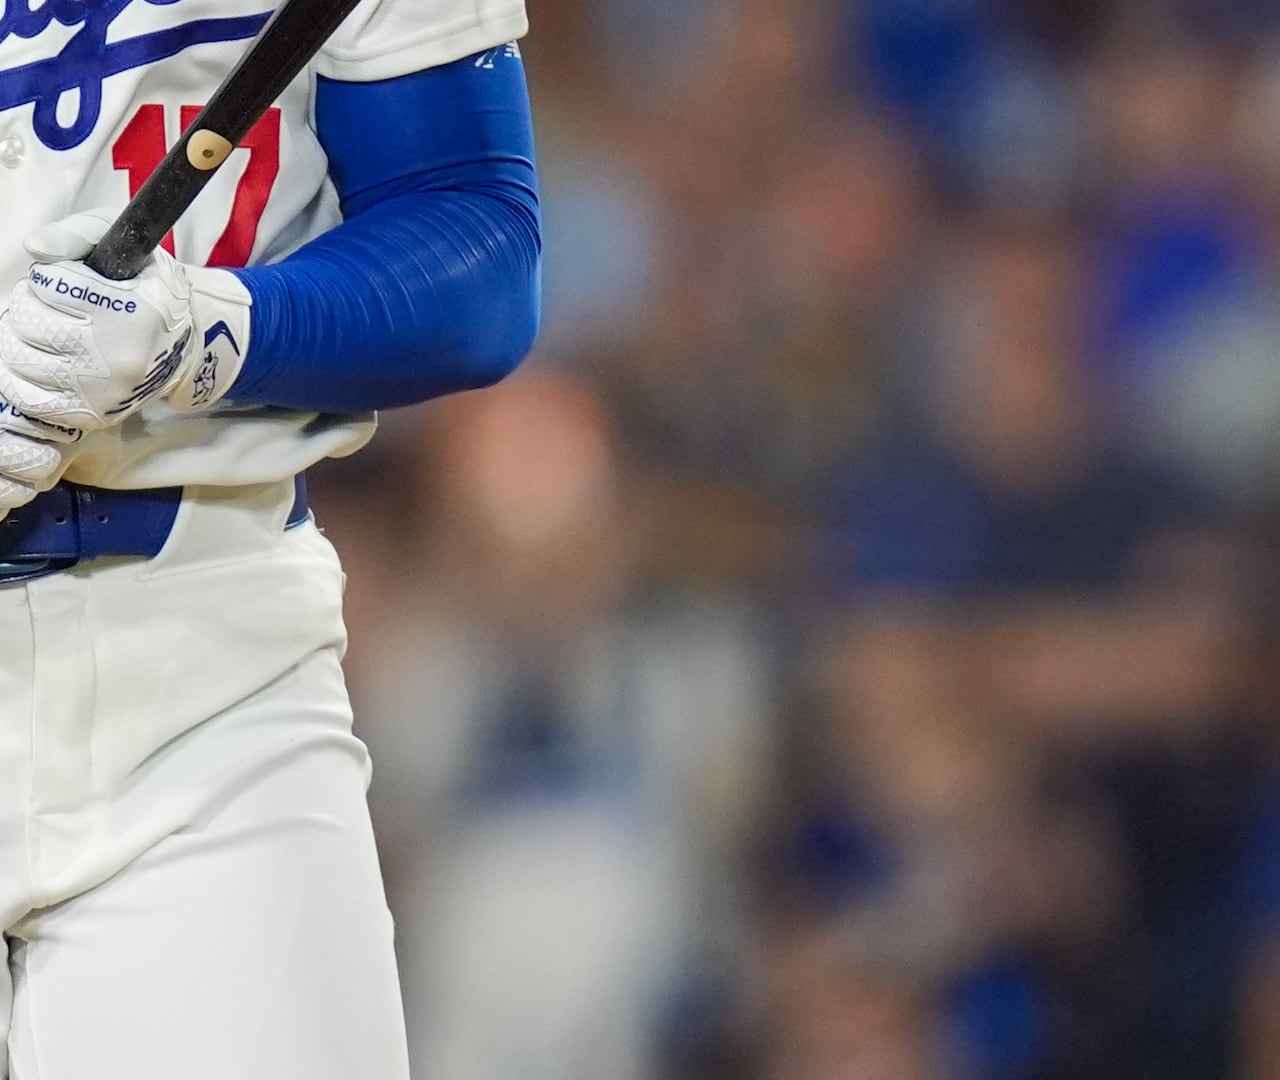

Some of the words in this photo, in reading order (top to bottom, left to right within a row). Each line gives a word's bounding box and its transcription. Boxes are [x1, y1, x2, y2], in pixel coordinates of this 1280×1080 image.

[111, 104, 281, 268] 17
[30, 269, 53, 288] new
[55, 278, 137, 314] balance
